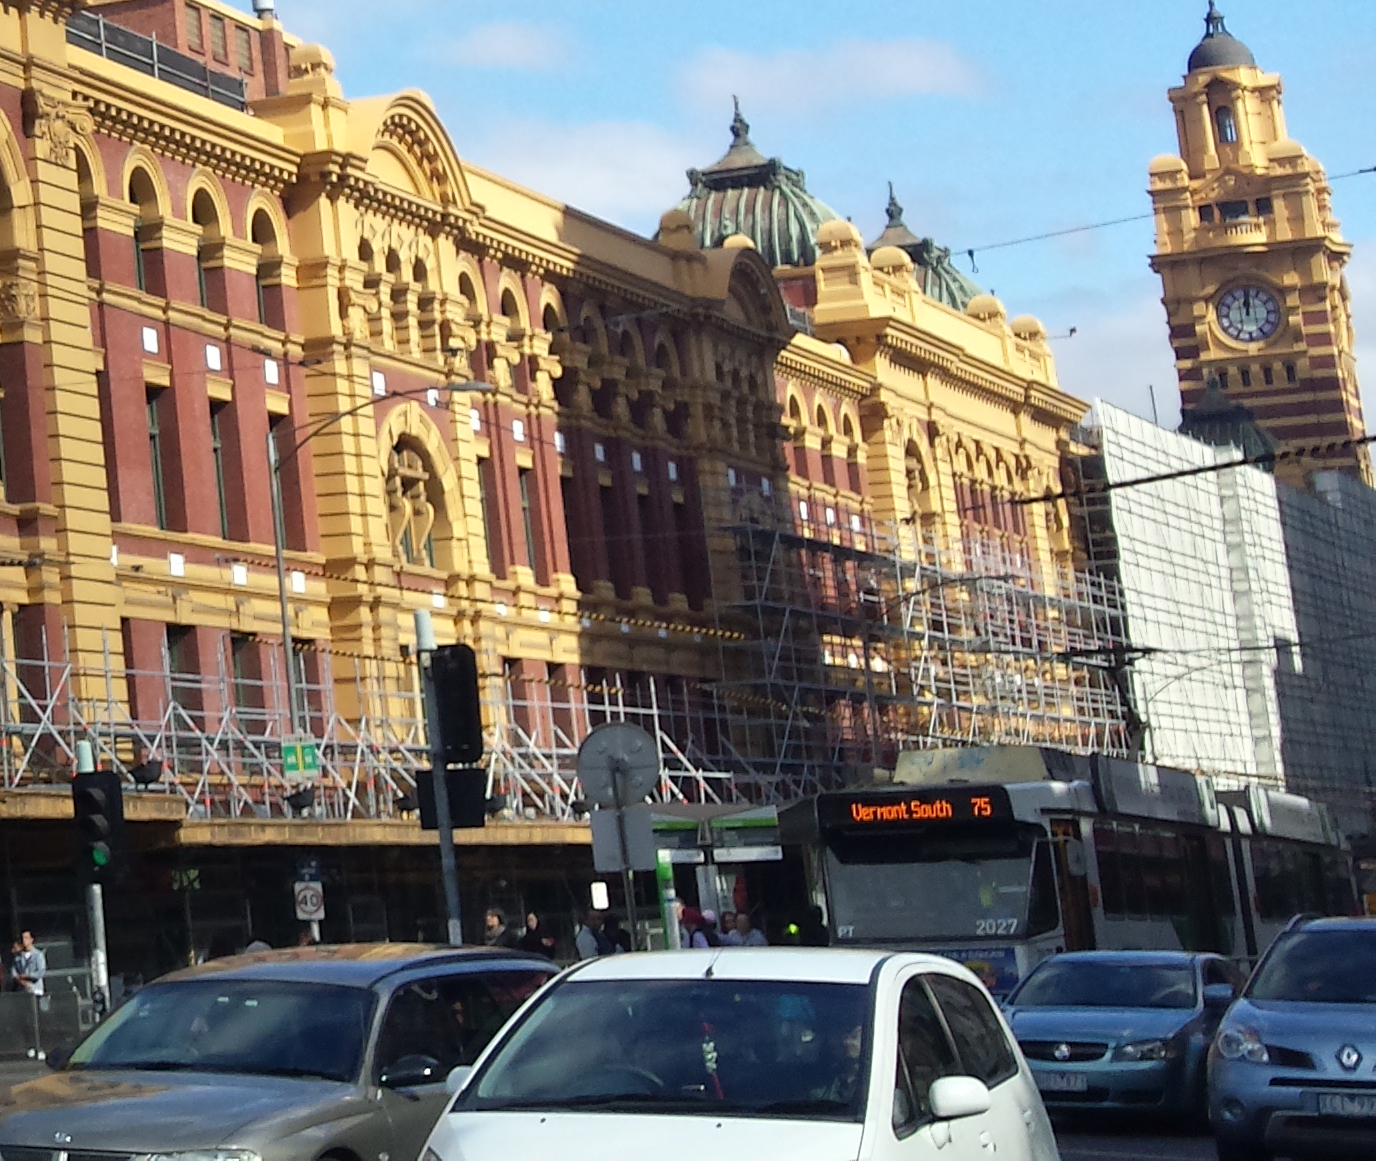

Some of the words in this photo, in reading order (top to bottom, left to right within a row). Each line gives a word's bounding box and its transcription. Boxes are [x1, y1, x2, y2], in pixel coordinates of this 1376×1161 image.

[850, 802, 908, 822] Vermont
[910, 799, 953, 819] South
[971, 796, 992, 817] 75
[300, 894, 319, 907] 40
[976, 918, 1018, 935] 2027
